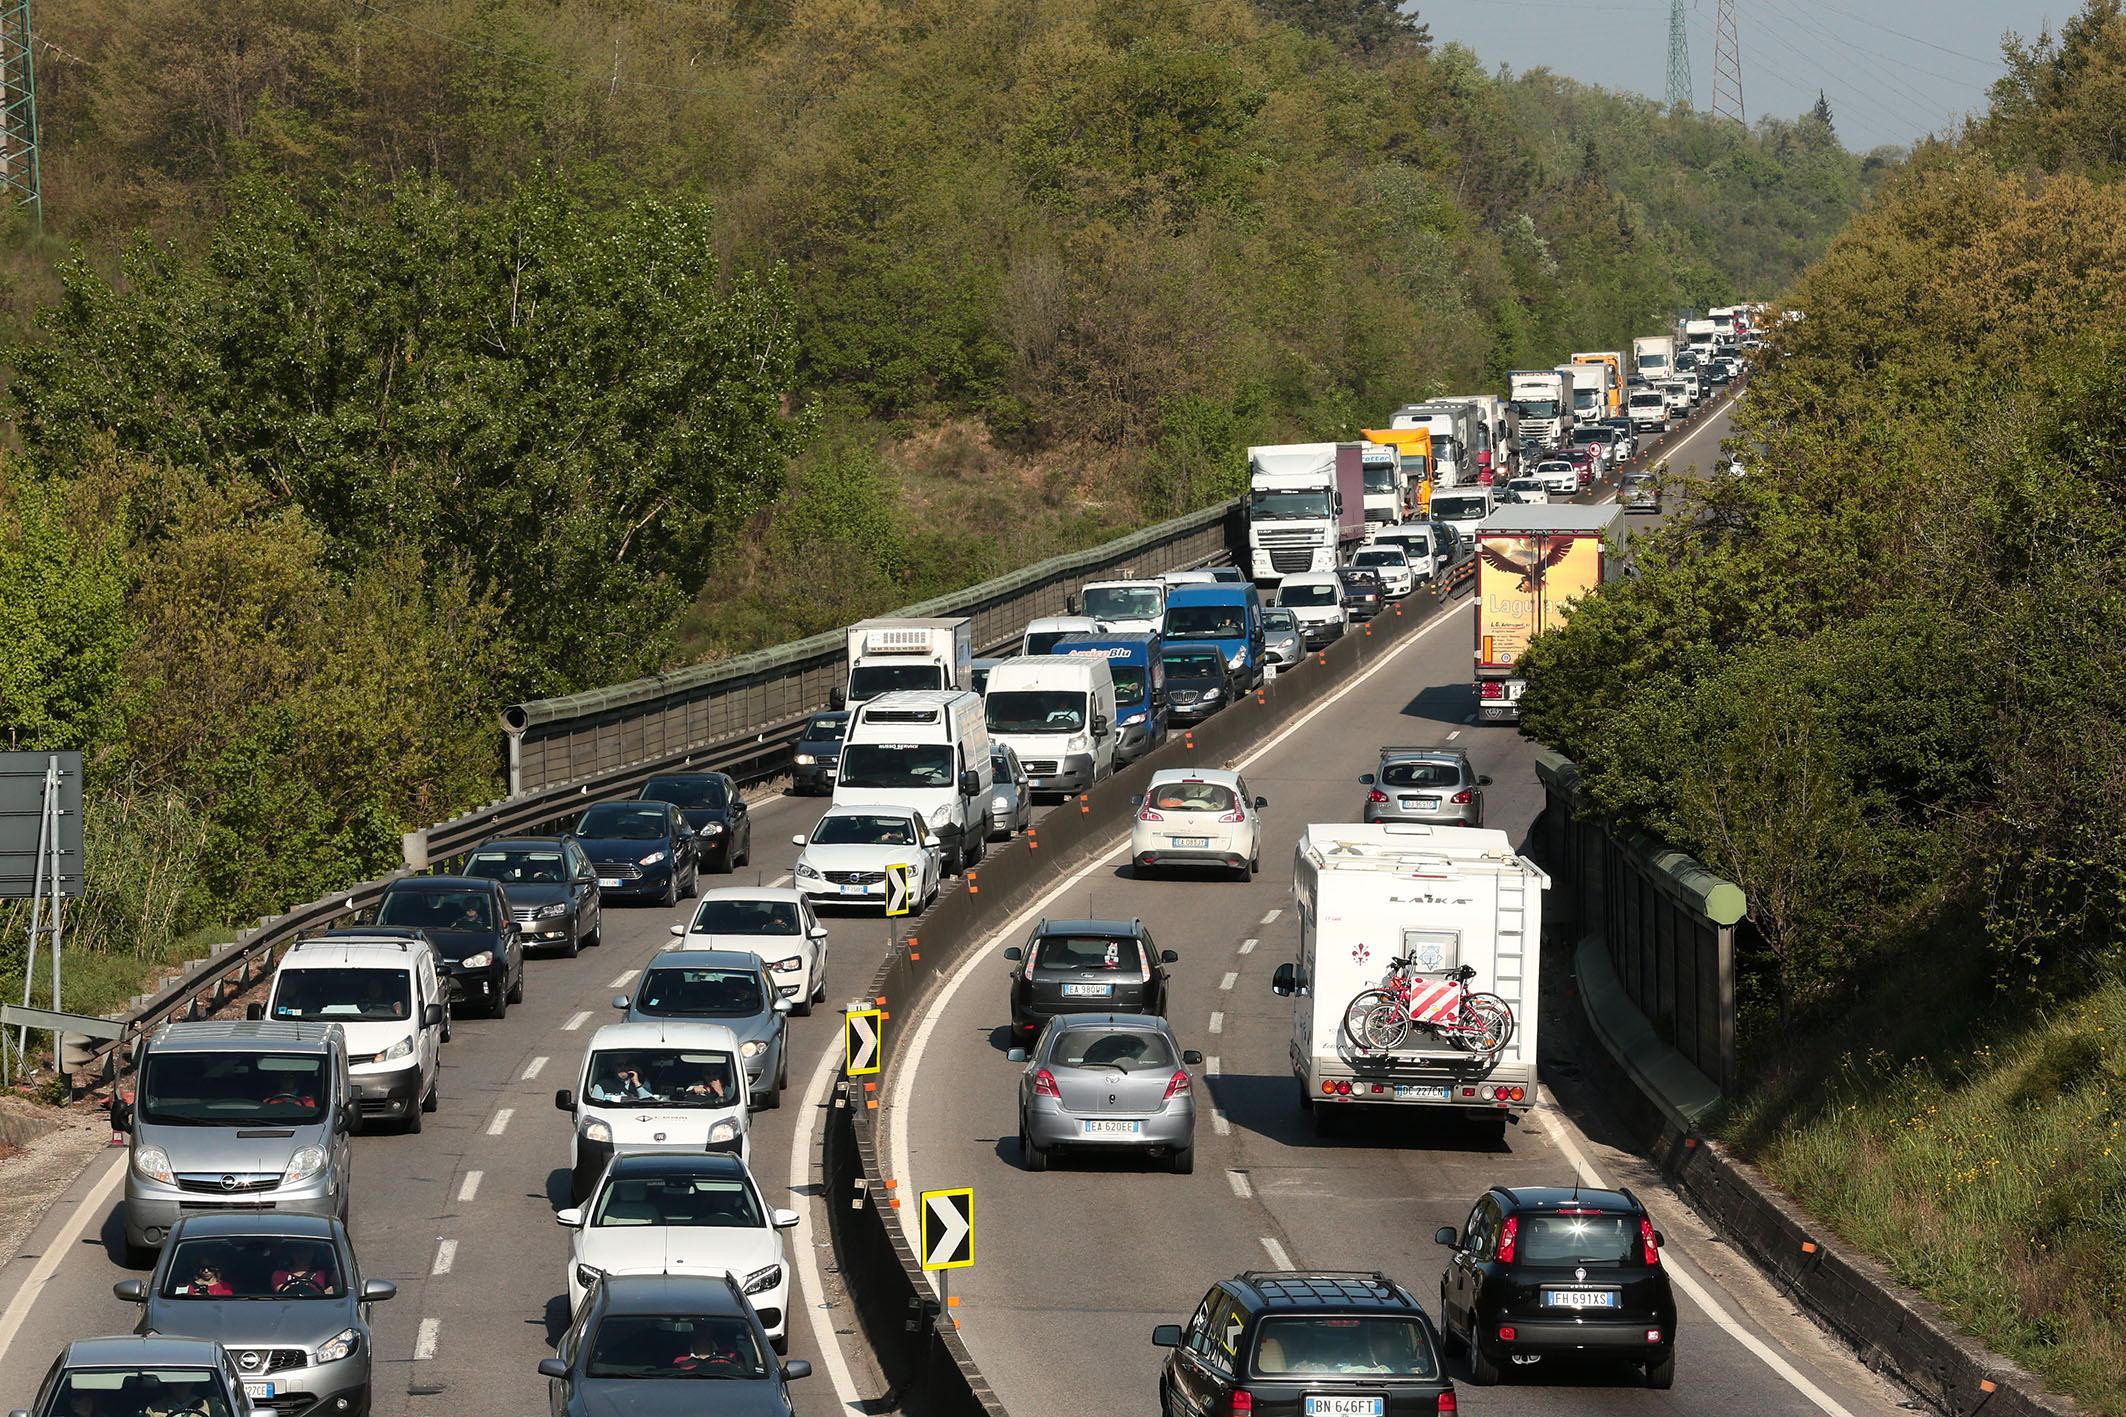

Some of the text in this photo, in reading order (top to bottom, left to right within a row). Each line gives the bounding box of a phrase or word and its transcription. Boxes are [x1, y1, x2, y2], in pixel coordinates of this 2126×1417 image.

[1389, 893, 1473, 905] LAIKA
[1069, 984, 1079, 994] EA
[1402, 1086, 1413, 1096] DC
[1091, 1122, 1133, 1132] EA 620EE
[1555, 1292, 1606, 1305] FH 691XS
[1315, 1400, 1373, 1413] BN 646FT
